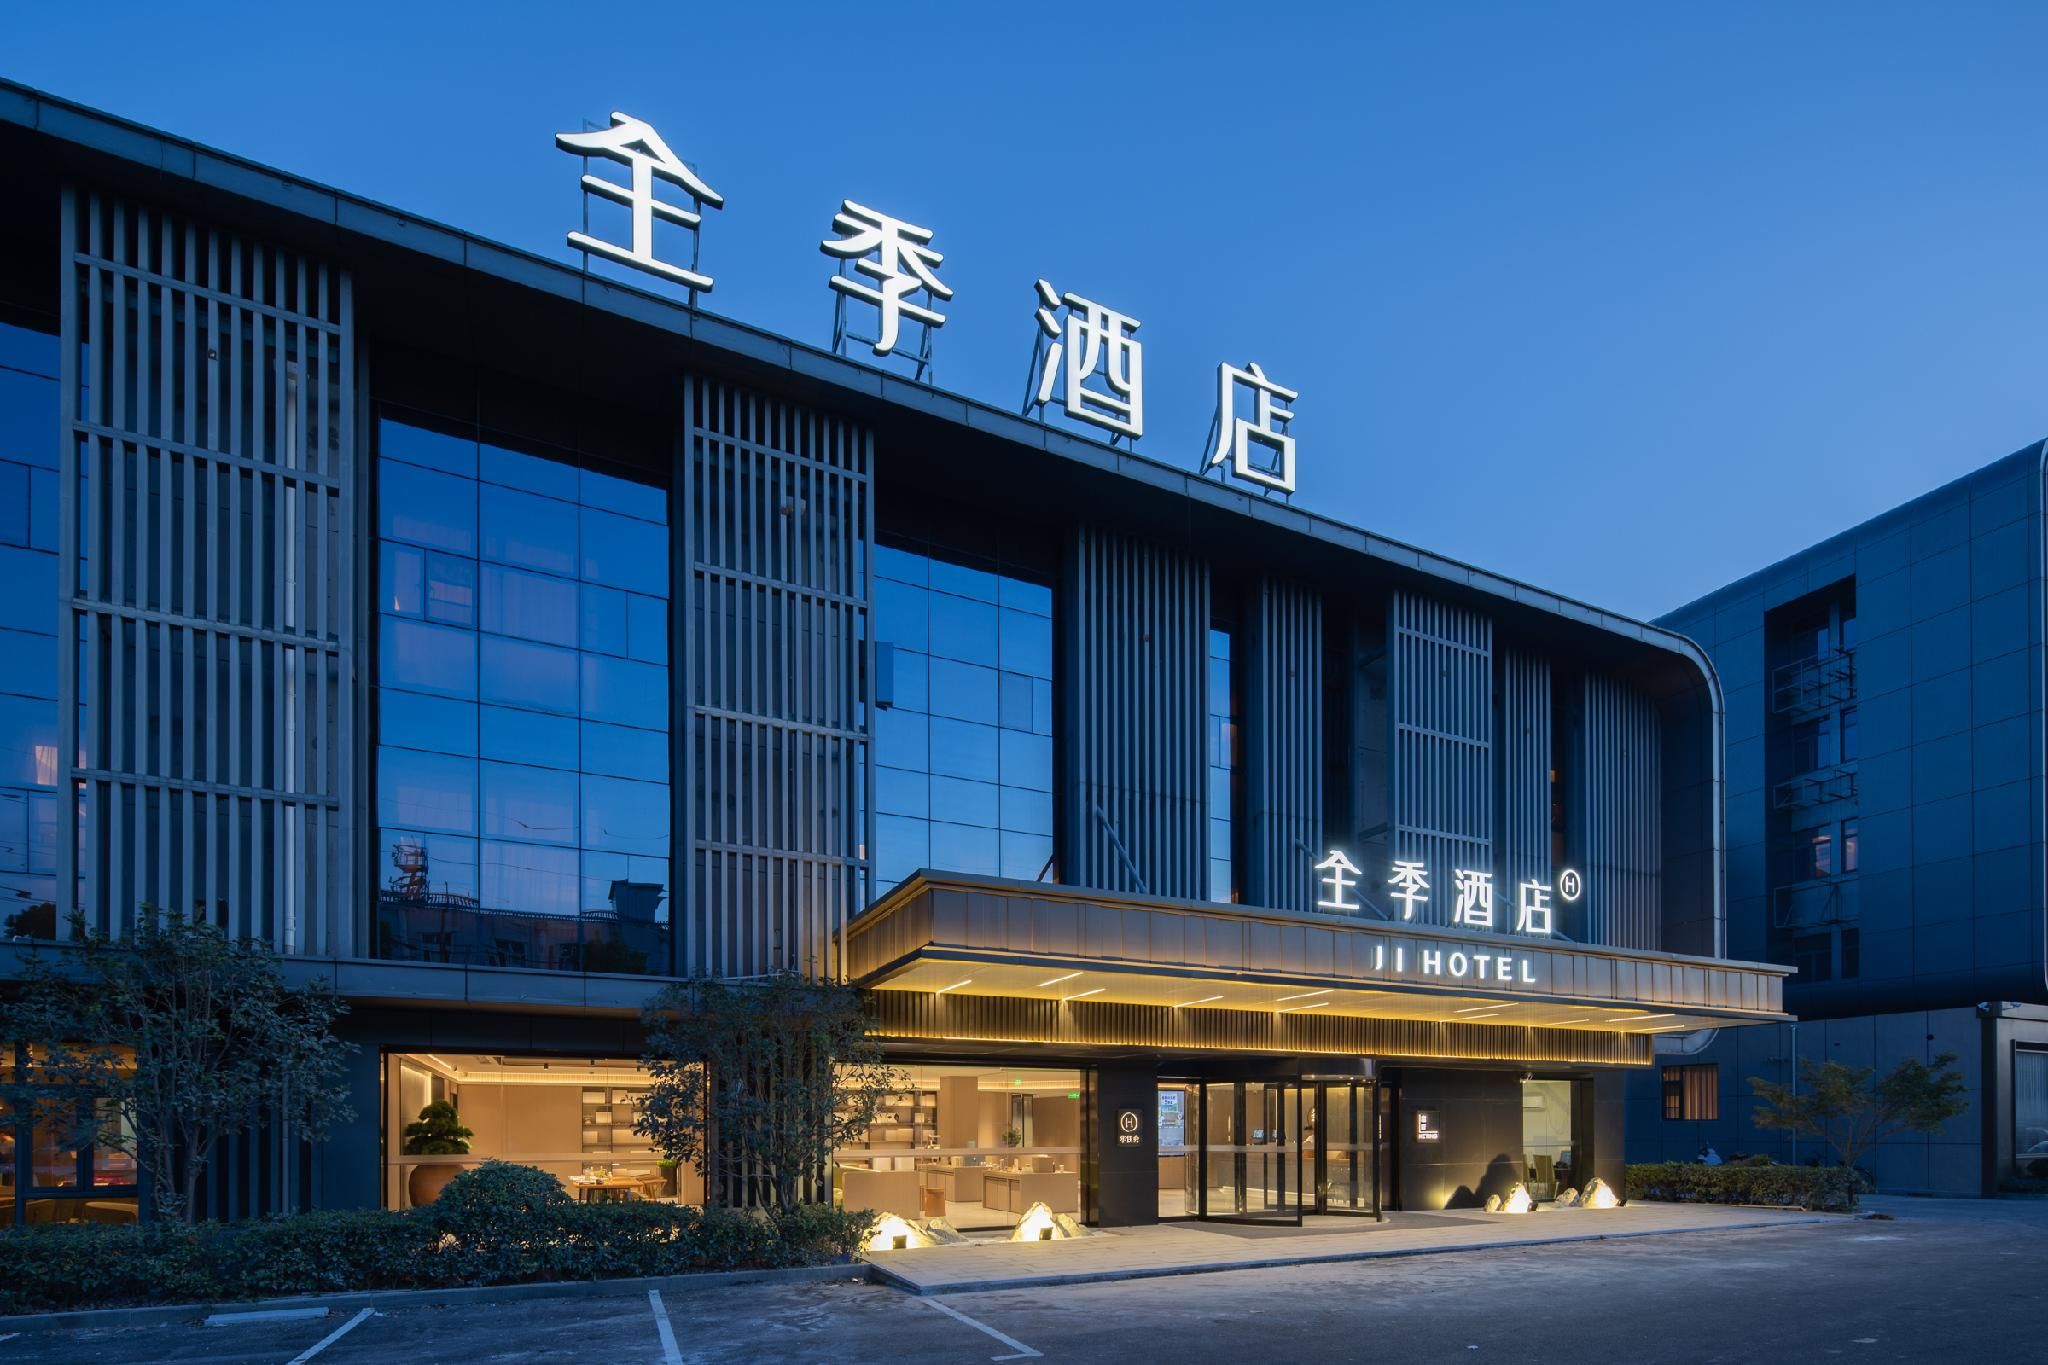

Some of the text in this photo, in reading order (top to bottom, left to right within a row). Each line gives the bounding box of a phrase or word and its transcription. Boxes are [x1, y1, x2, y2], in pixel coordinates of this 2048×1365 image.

[555, 111, 1298, 493] 全季酒店
[1315, 849, 1551, 933] 全季酒店
[1374, 945, 1536, 983] JI HOTEL
